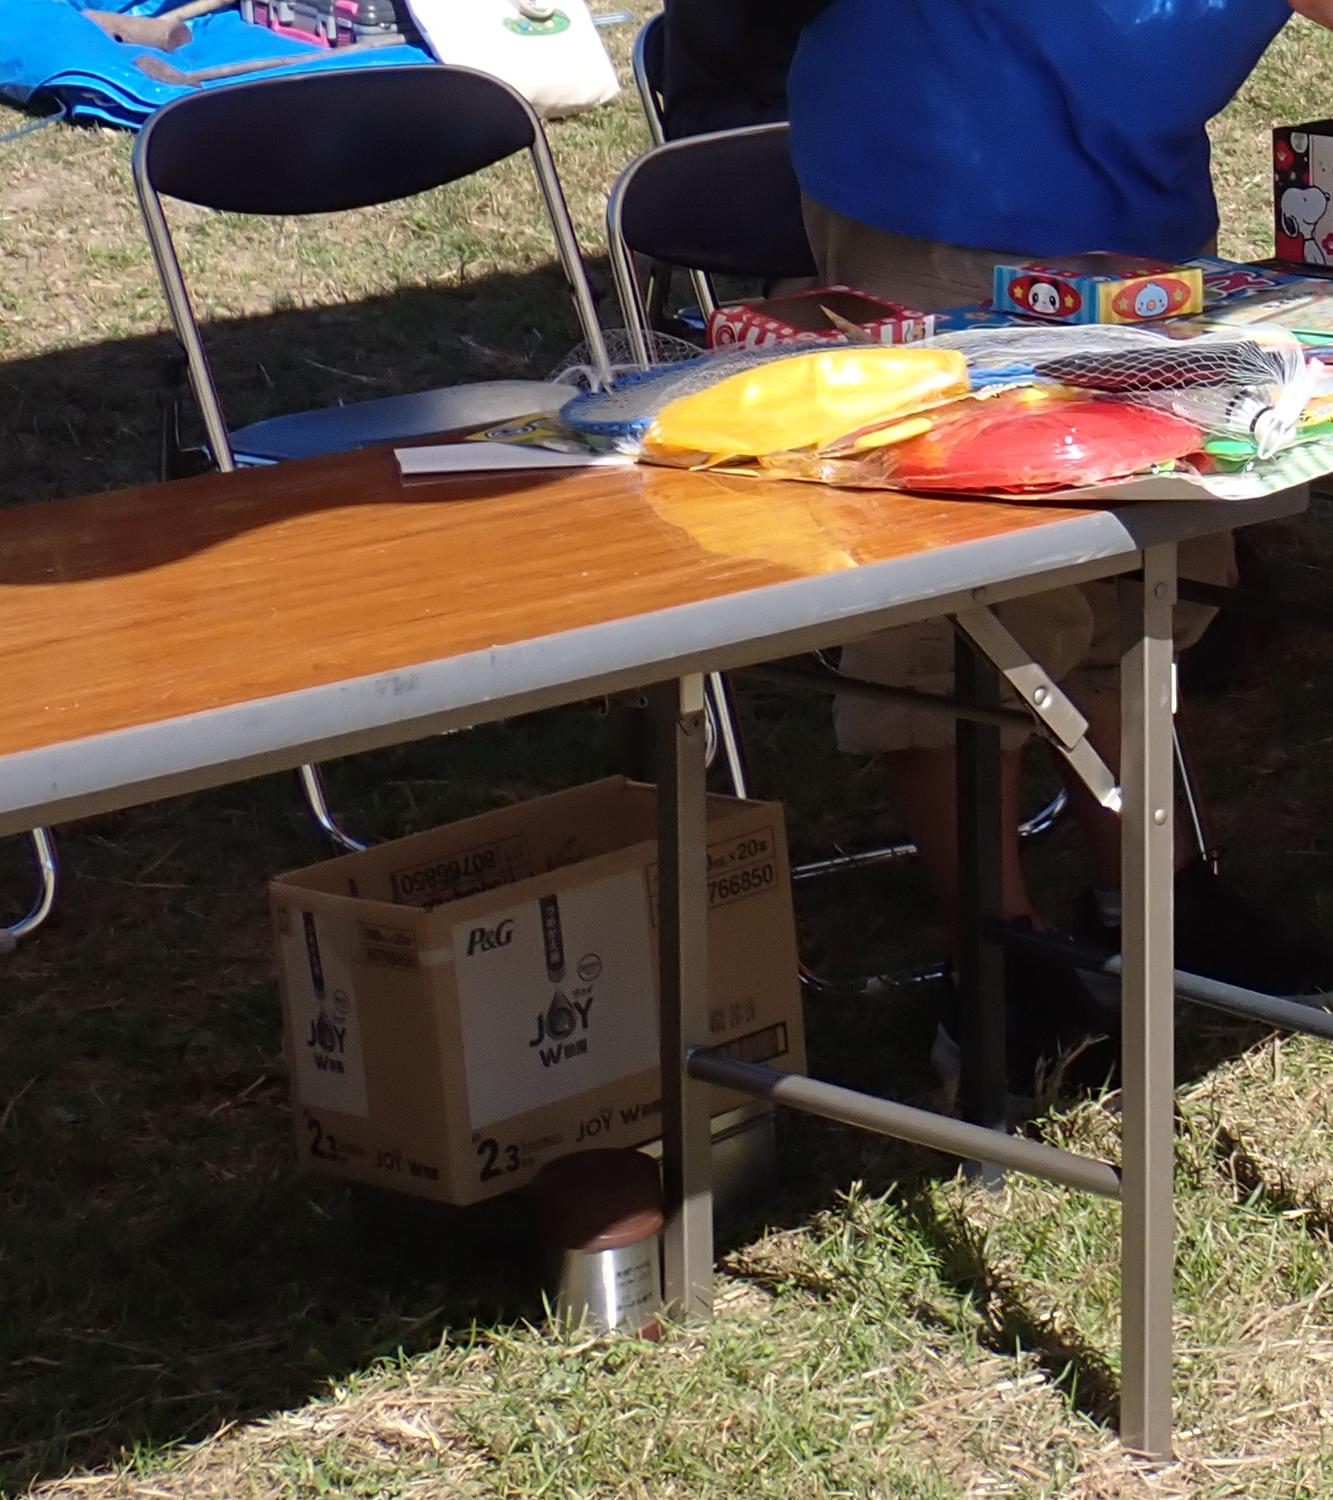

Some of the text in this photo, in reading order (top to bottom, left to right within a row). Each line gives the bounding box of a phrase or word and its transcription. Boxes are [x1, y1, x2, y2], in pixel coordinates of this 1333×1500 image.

[707, 863, 774, 904] 766850
[466, 918, 514, 957] P&G
[307, 1005, 347, 1055] JOY
[529, 989, 594, 1048] JOY
[575, 1108, 613, 1142] JOY
